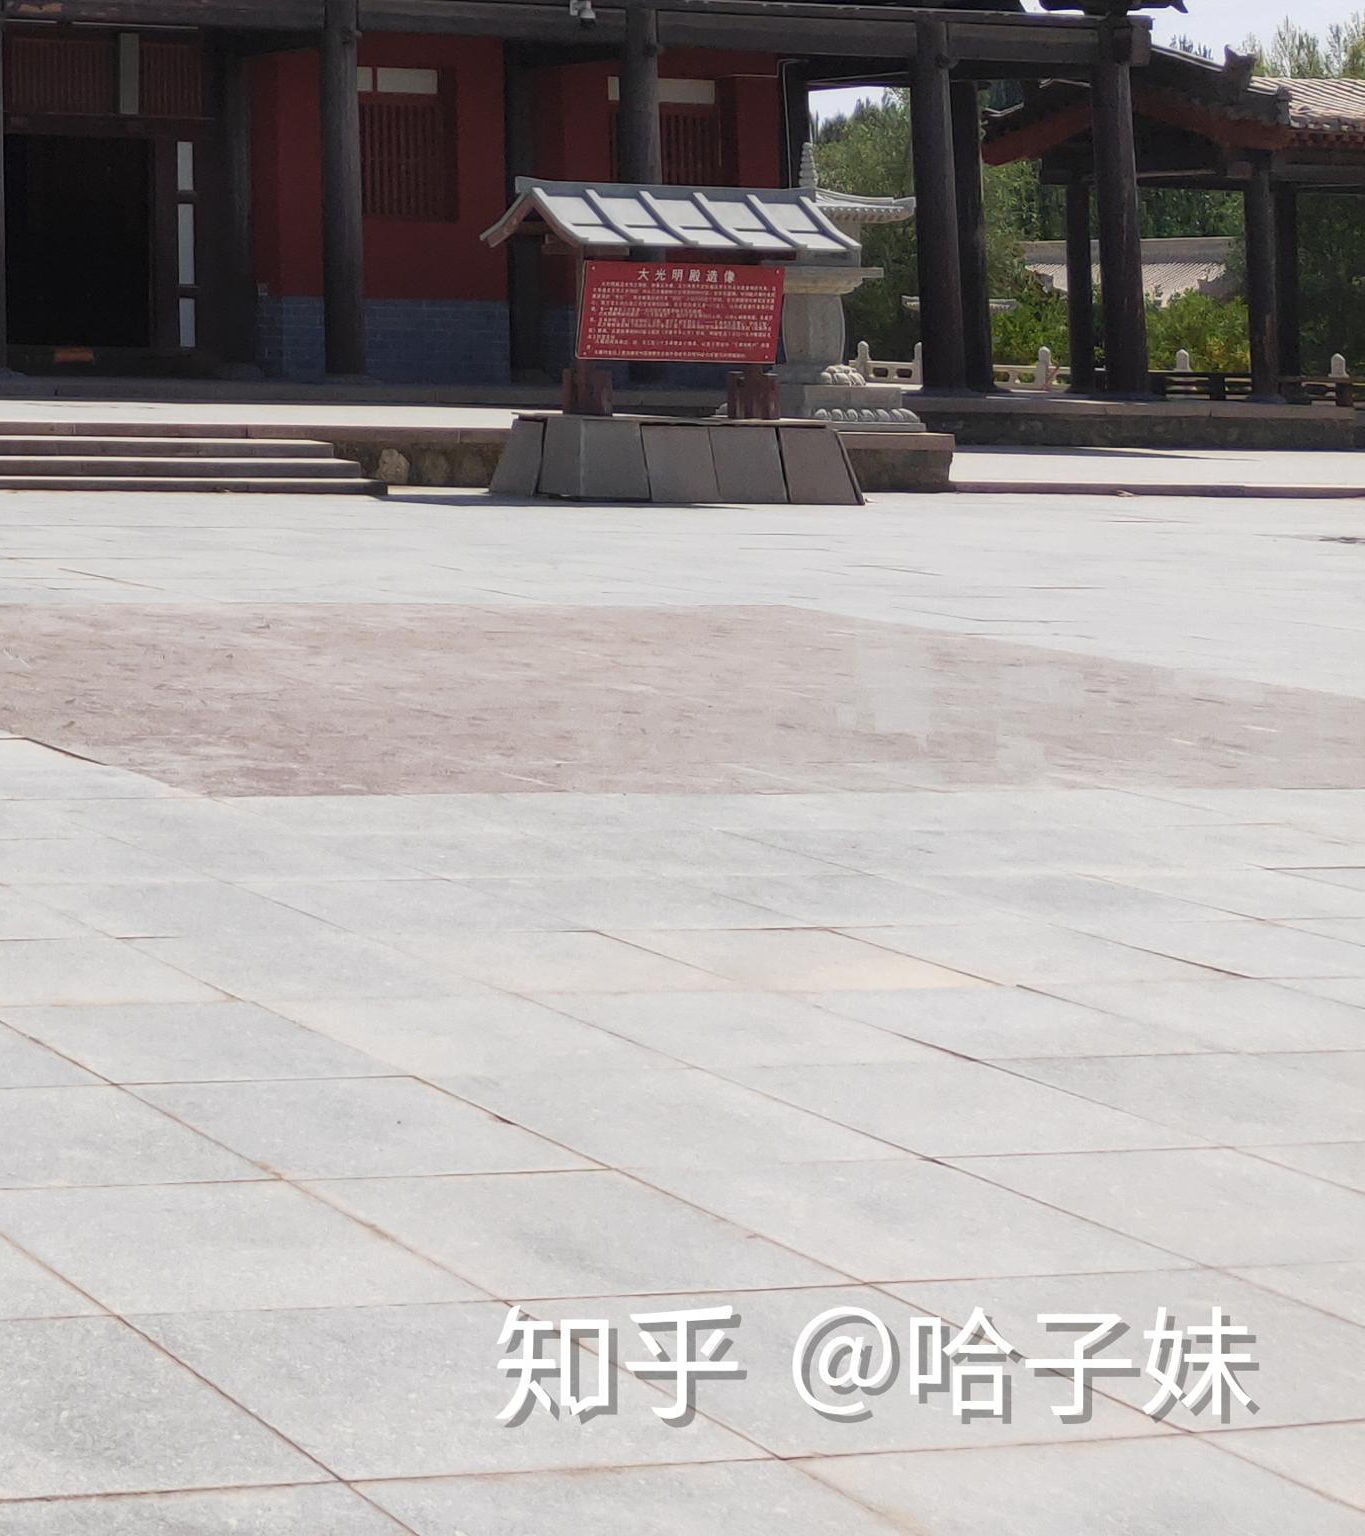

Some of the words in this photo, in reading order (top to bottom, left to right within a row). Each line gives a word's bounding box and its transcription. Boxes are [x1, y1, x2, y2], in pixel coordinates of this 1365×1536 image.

[637, 268, 736, 282] 大光明殿造像
